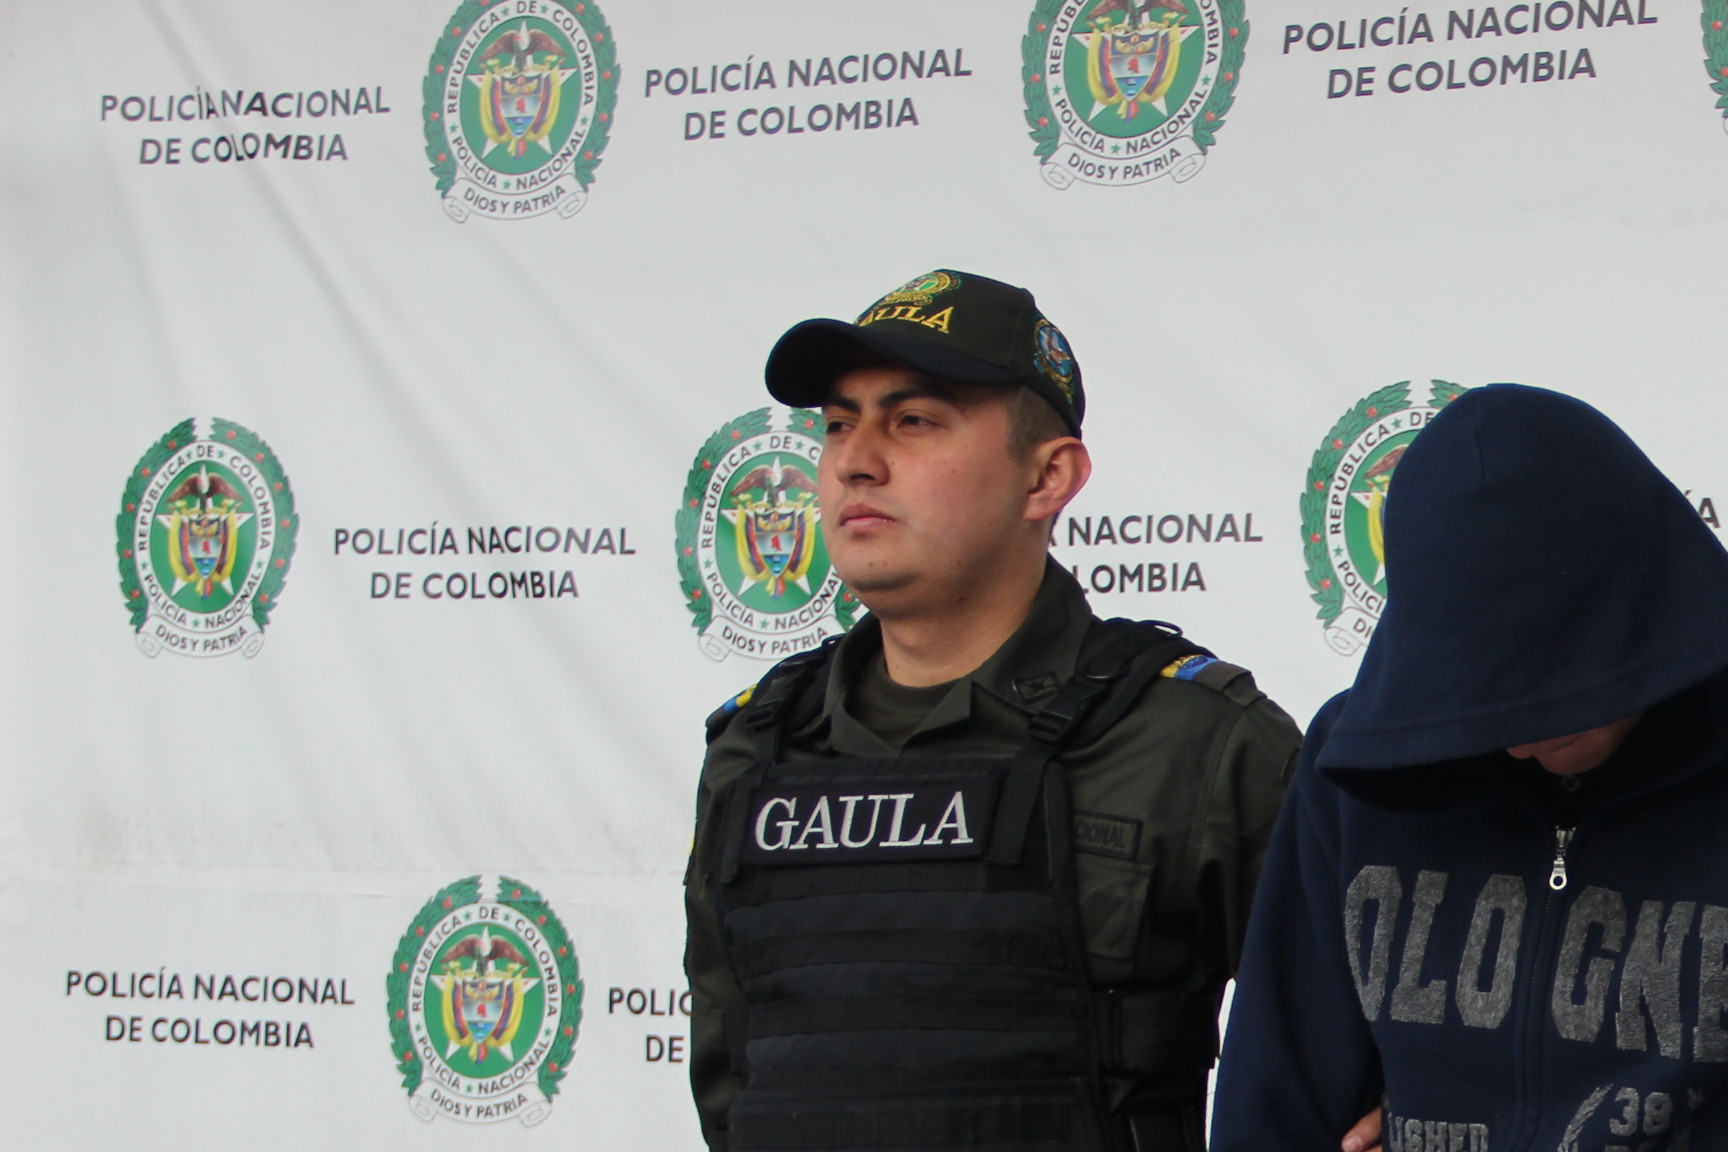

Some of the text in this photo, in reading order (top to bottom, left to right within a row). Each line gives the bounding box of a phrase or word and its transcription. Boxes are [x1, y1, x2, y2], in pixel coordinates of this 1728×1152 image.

[1200, 0, 1218, 65] OMBIA
[1282, 0, 1658, 55] POLICÍA NACIONAL
[517, 0, 536, 13] DE
[554, 10, 594, 105] COLOMBIA
[644, 47, 973, 98] POLICÍA NACIONAL
[1327, 47, 1597, 100] DE COLOMBIA
[221, 86, 391, 119] NACIONAL
[684, 97, 920, 141] DE COLOMBIA
[1127, 89, 1206, 154] NACIONAL
[139, 132, 348, 165] DE COLOMBIA
[517, 129, 585, 190] NACIONAL
[1124, 148, 1180, 179] PATRIA
[515, 185, 564, 214] PATRIA
[769, 436, 789, 448] DE
[334, 520, 636, 556] POLICÍA NACIONAL
[1068, 512, 1263, 547] NACIONAL
[370, 570, 579, 600] DE COLOMBIA
[1073, 562, 1207, 595] LOMBIA
[775, 570, 839, 630] NACIONA
[774, 626, 824, 654] PATRIA
[754, 791, 974, 851] GAULA
[479, 907, 498, 920] DE
[515, 919, 556, 1016] COLOMBIA
[66, 966, 355, 1005] POLICÍA NACIONAL
[608, 986, 692, 1017] POLIC
[105, 1015, 314, 1049] DE COLOMBIA
[645, 1034, 684, 1063] DE
[481, 1040, 547, 1095] NACIONAL
